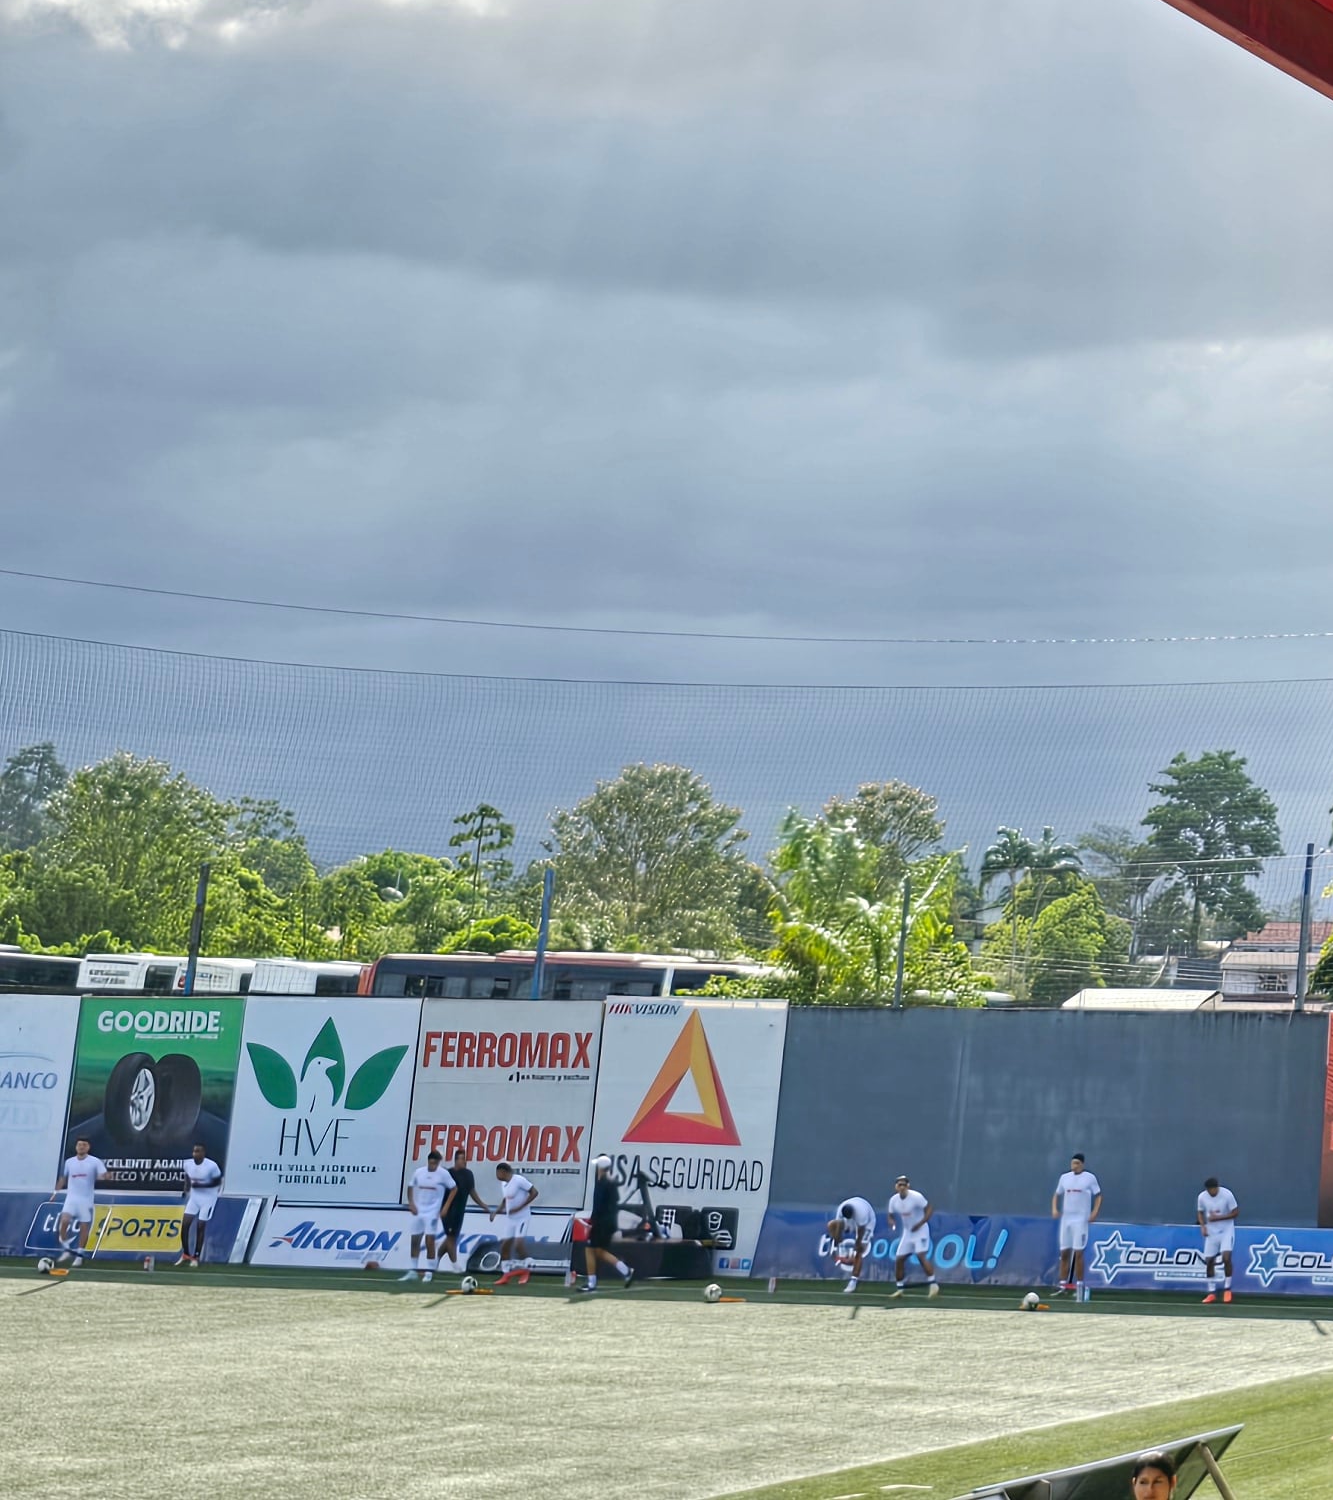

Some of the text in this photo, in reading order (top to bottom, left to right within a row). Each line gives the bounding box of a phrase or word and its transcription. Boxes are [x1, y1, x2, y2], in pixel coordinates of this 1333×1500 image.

[97, 1010, 222, 1033] GOODRIDE
[423, 1031, 593, 1069] FERROMAX
[0, 1071, 57, 1089] ANCO
[279, 1118, 356, 1156] HVF
[412, 1125, 585, 1162] FERROMAX
[140, 1172, 147, 1181] Y
[649, 1156, 763, 1192] SEGURIDAD
[96, 1219, 181, 1238] SPORTS
[269, 1221, 402, 1251] AKRON
